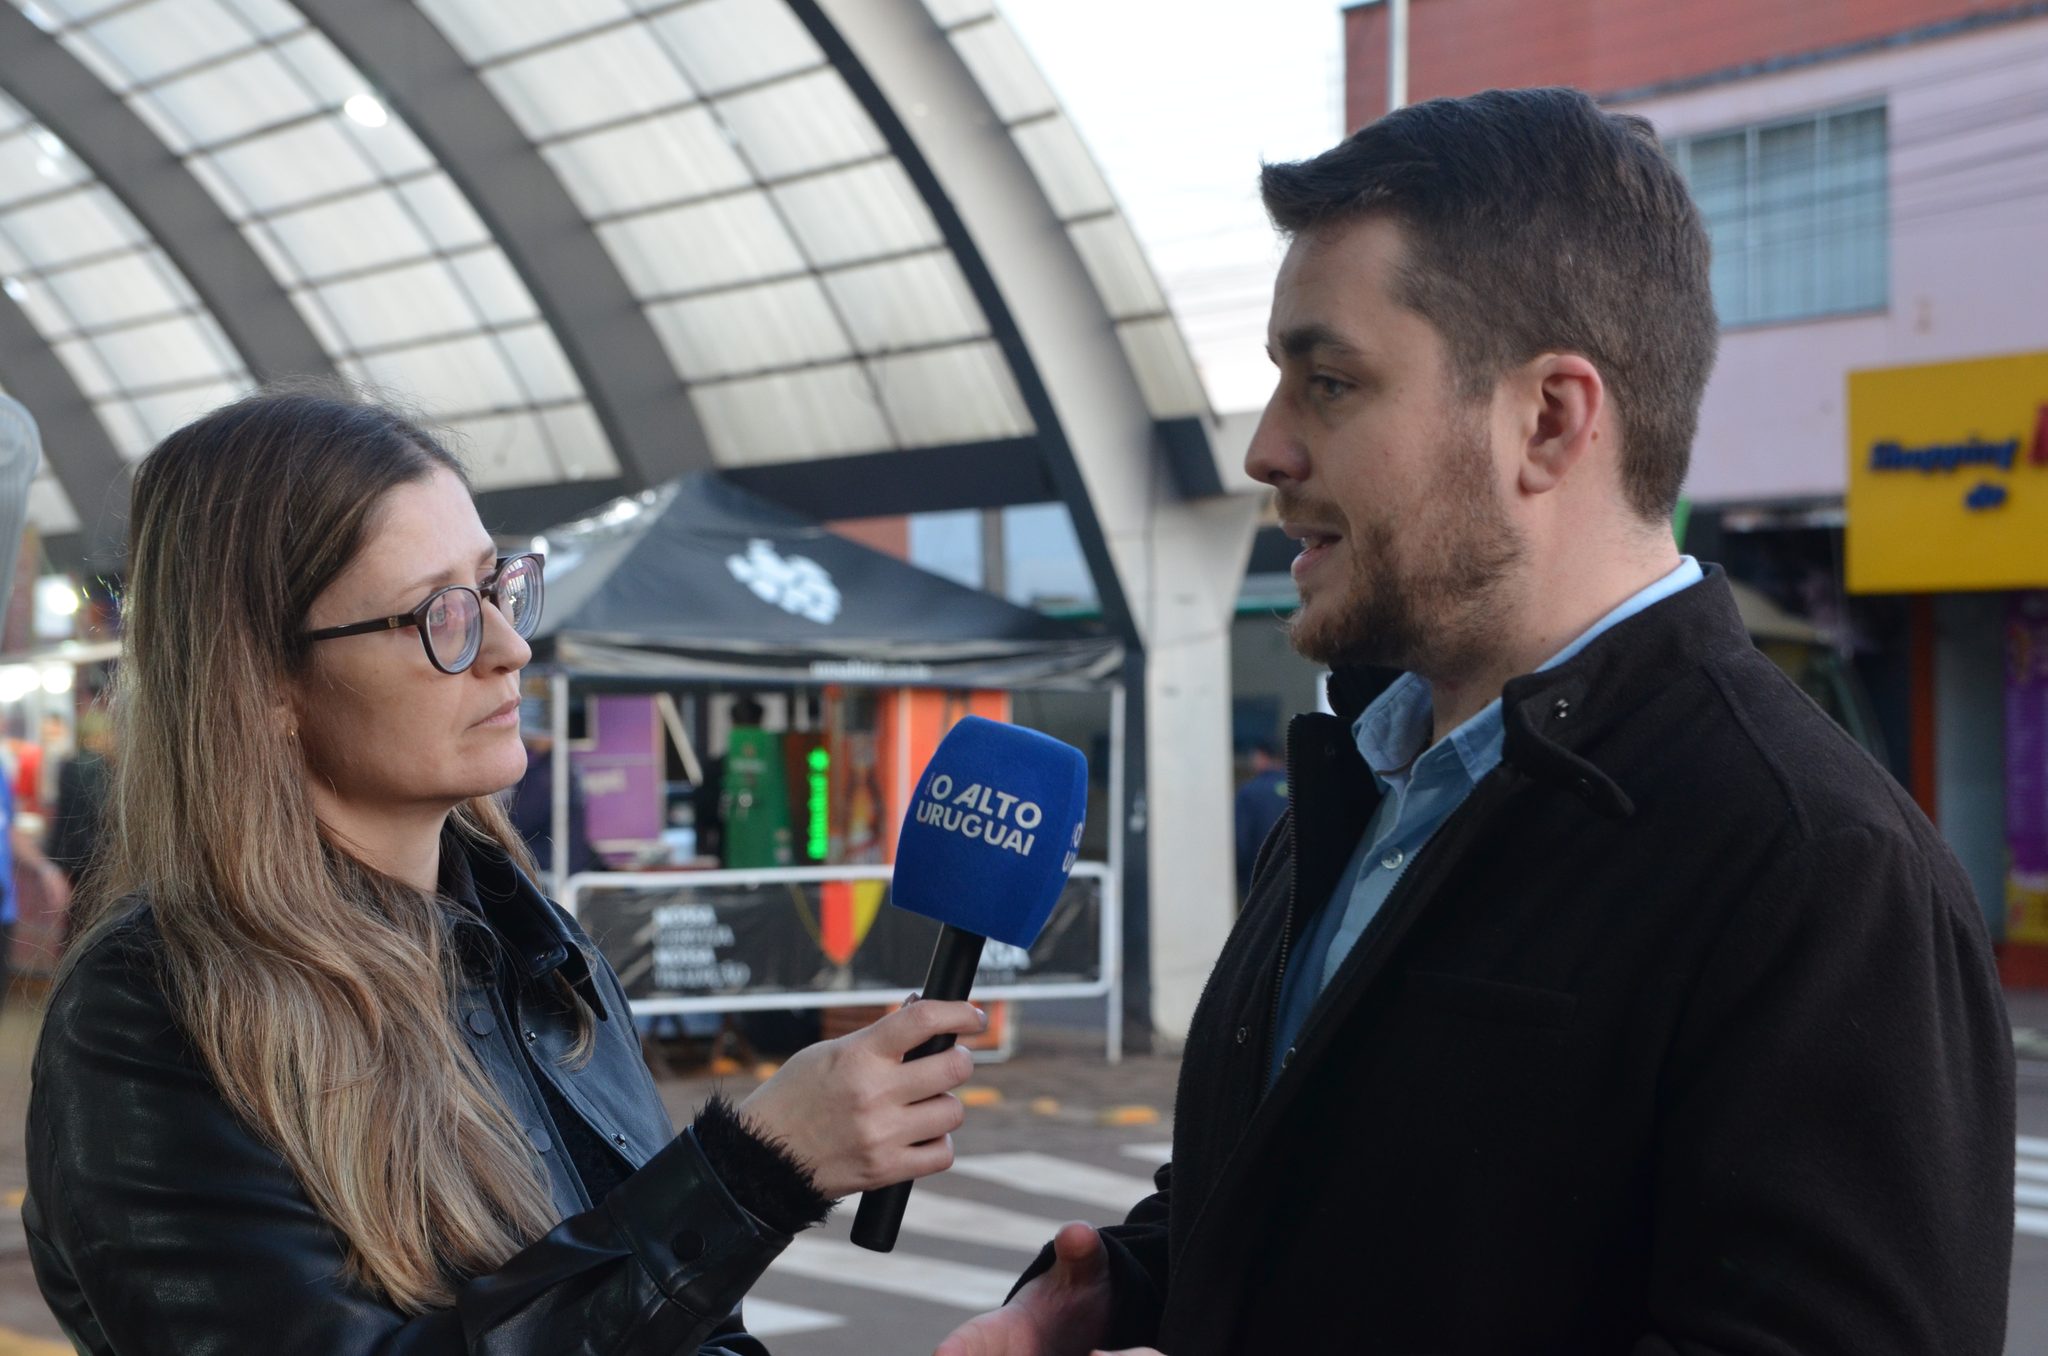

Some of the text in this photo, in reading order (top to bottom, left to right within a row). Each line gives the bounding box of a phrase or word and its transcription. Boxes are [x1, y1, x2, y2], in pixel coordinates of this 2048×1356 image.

[916, 799, 1035, 857] URUGUAI
[931, 774, 953, 800] O
[952, 783, 1042, 830] ALTO
